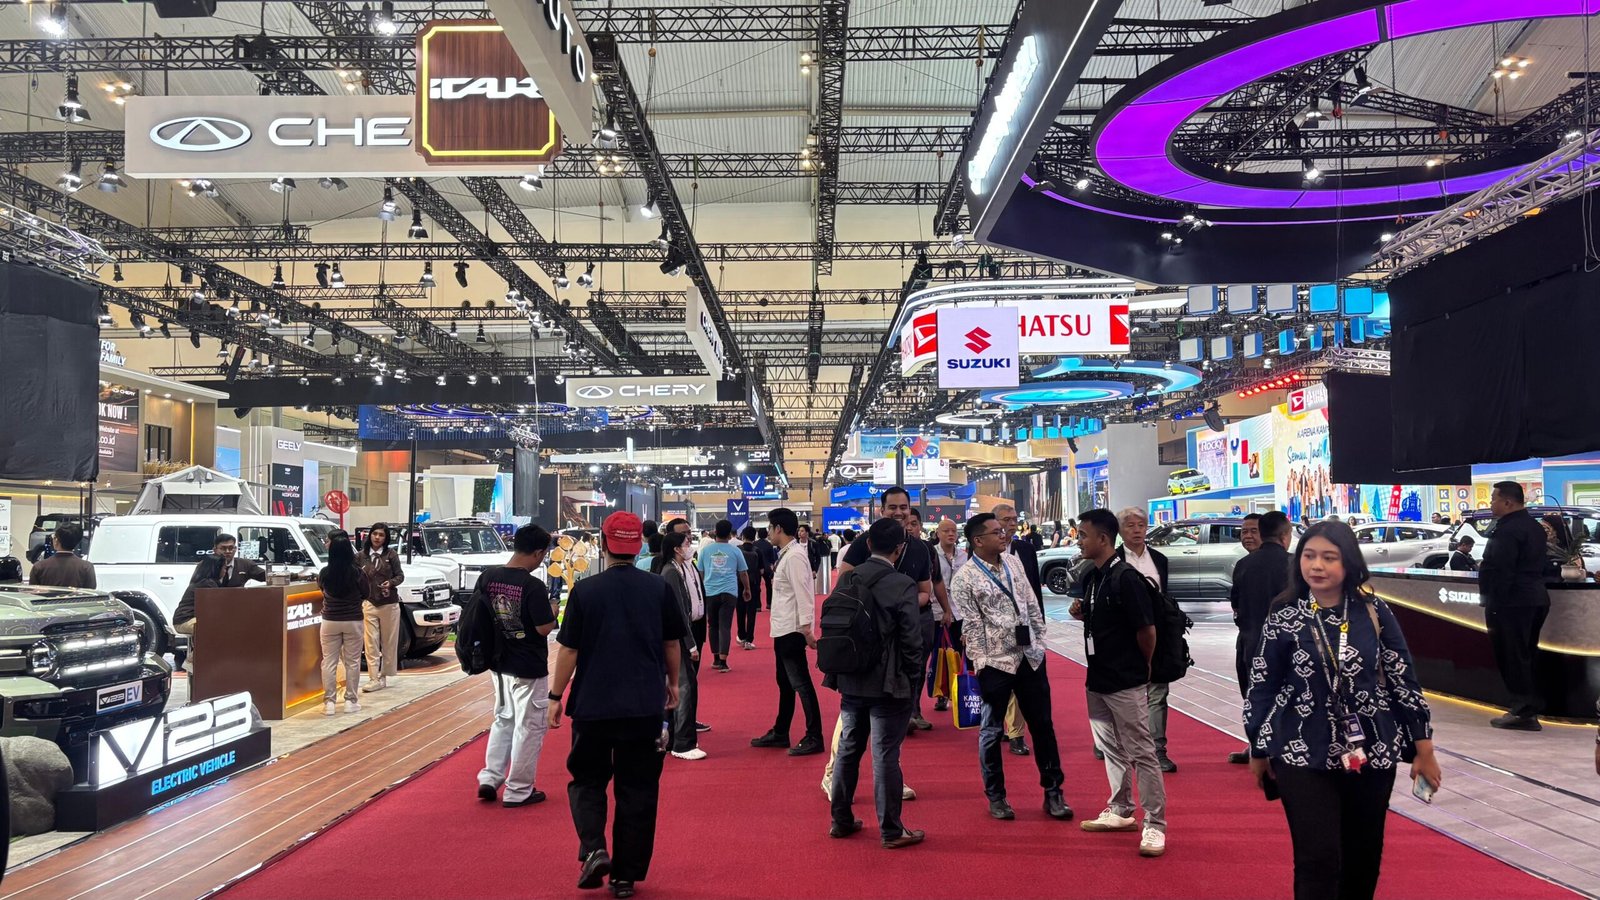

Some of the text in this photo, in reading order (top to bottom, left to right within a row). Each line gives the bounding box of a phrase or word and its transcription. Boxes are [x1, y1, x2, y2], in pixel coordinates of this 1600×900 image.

[539, 0, 585, 82] UTO
[268, 117, 411, 146] CHE
[101, 340, 116, 351] FOR
[100, 352, 126, 366] FAMILY
[947, 358, 1010, 369] SUZUKI
[620, 384, 706, 396] CHERY
[277, 440, 301, 451] GEELY
[682, 469, 725, 478] ZEEKR
[127, 685, 140, 702] EV
[98, 690, 252, 790] V23
[151, 769, 198, 796] ELECTRIC
[199, 750, 235, 776] VEHICLE
